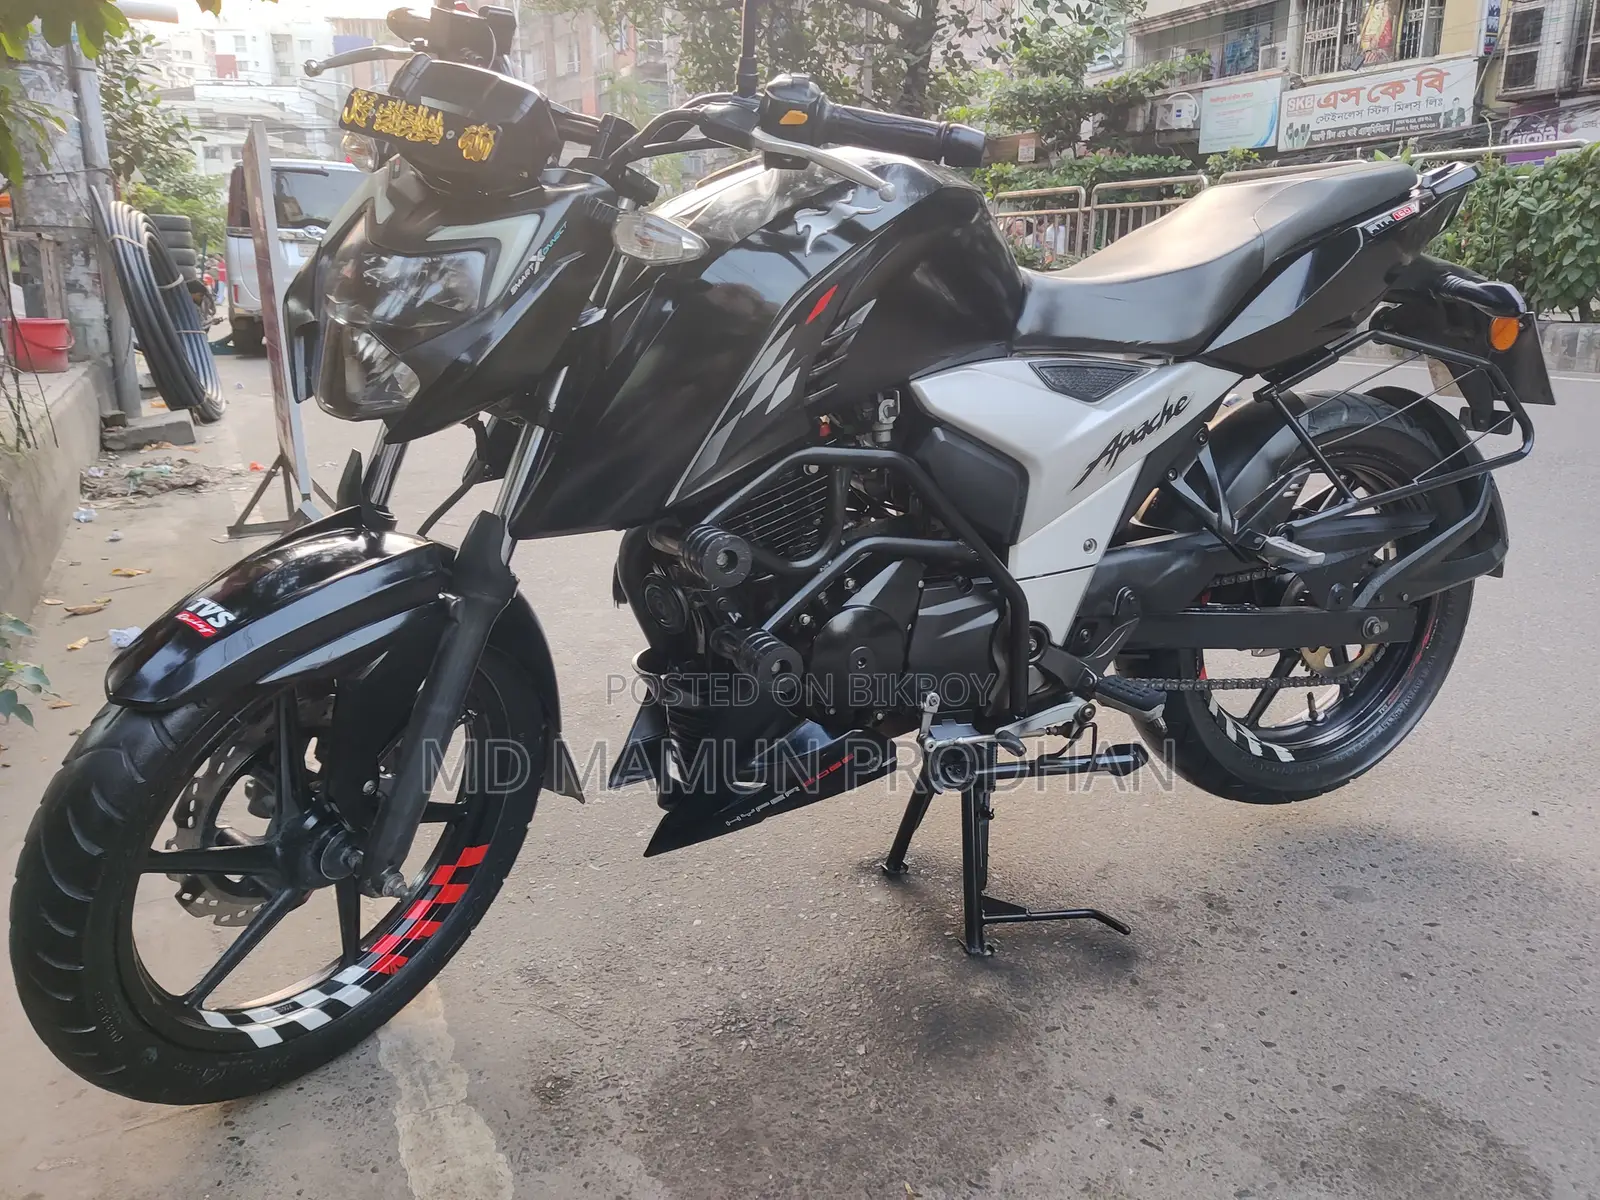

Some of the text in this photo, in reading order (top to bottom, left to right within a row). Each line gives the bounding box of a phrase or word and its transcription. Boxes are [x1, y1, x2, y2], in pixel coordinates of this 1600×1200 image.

[1287, 94, 1315, 112] SKB
[1317, 67, 1451, 109] এস কে বি
[1069, 393, 1193, 491] Apache
[185, 597, 236, 628] TVS
